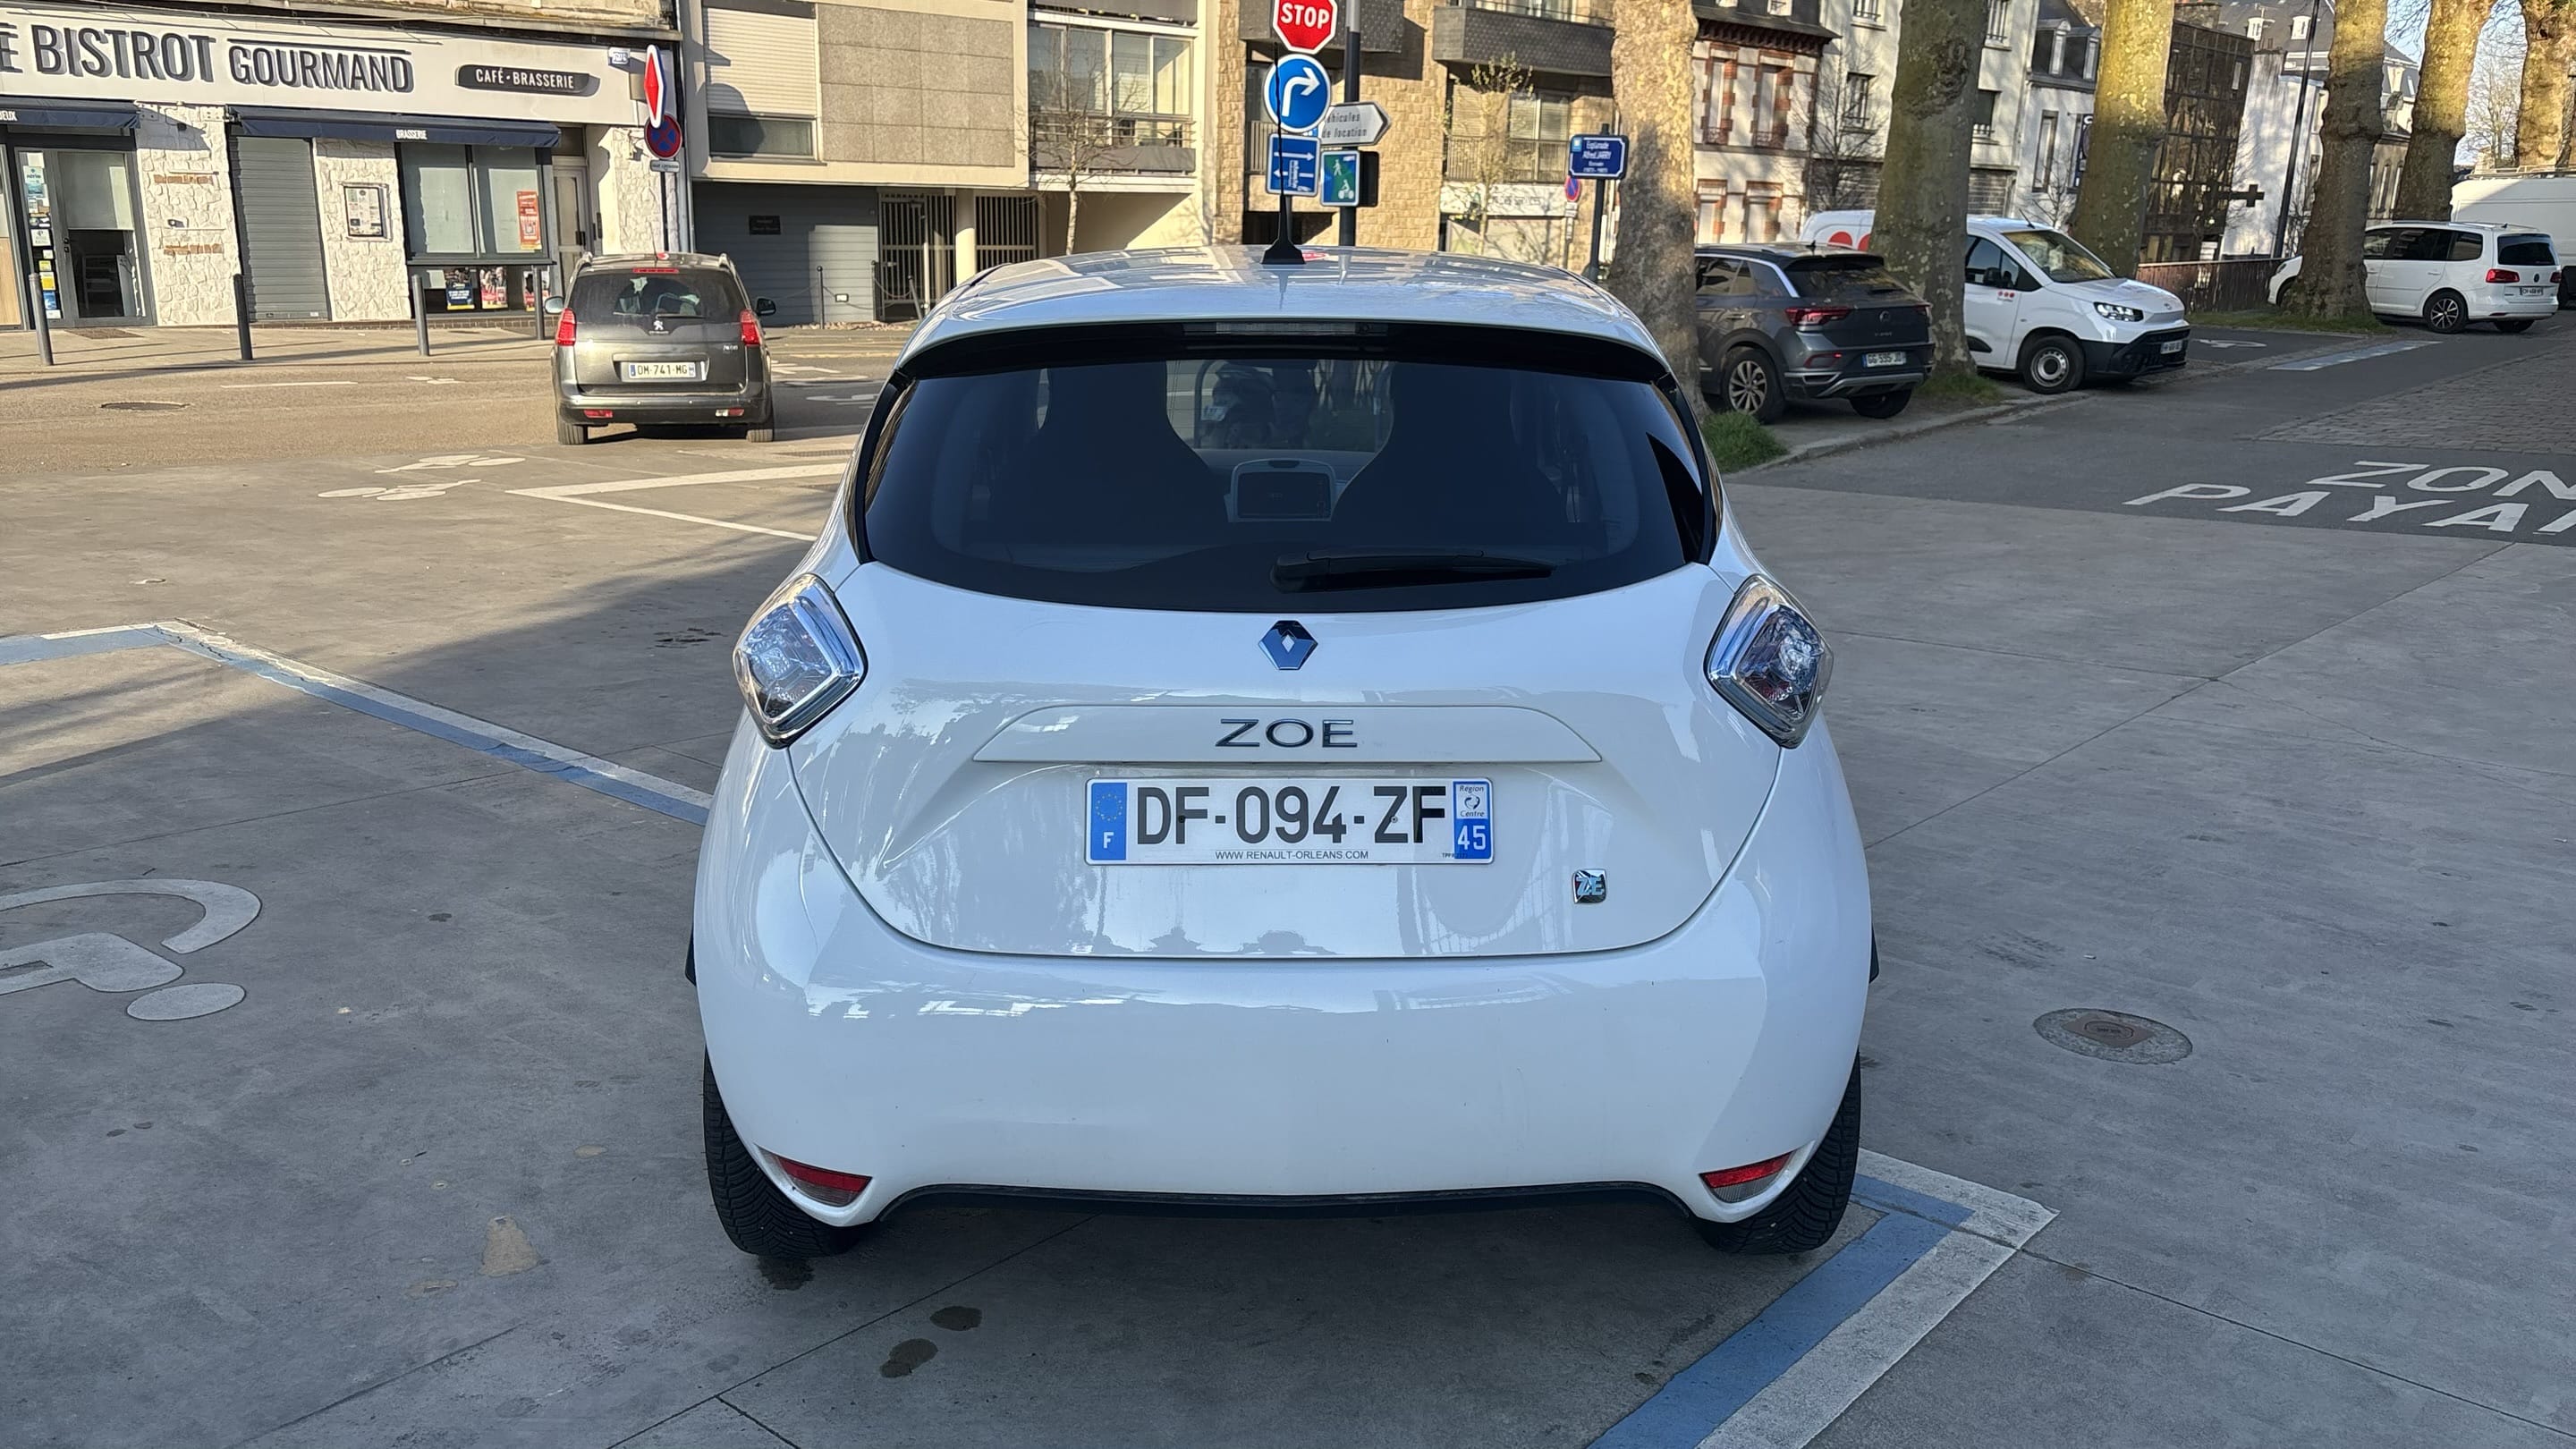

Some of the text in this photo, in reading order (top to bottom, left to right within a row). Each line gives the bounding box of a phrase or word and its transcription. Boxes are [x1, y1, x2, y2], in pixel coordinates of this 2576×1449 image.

[1280, 3, 1330, 30] STOP
[30, 24, 216, 82] BISTROT
[229, 46, 415, 93] GOURMAND
[513, 72, 574, 89] BRASSERIE
[1334, 128, 1368, 138] location
[1215, 718, 1358, 748] ZOE
[1137, 785, 1446, 844] DF-094-ZF
[1103, 831, 1114, 849] F
[1457, 825, 1487, 851] 45
